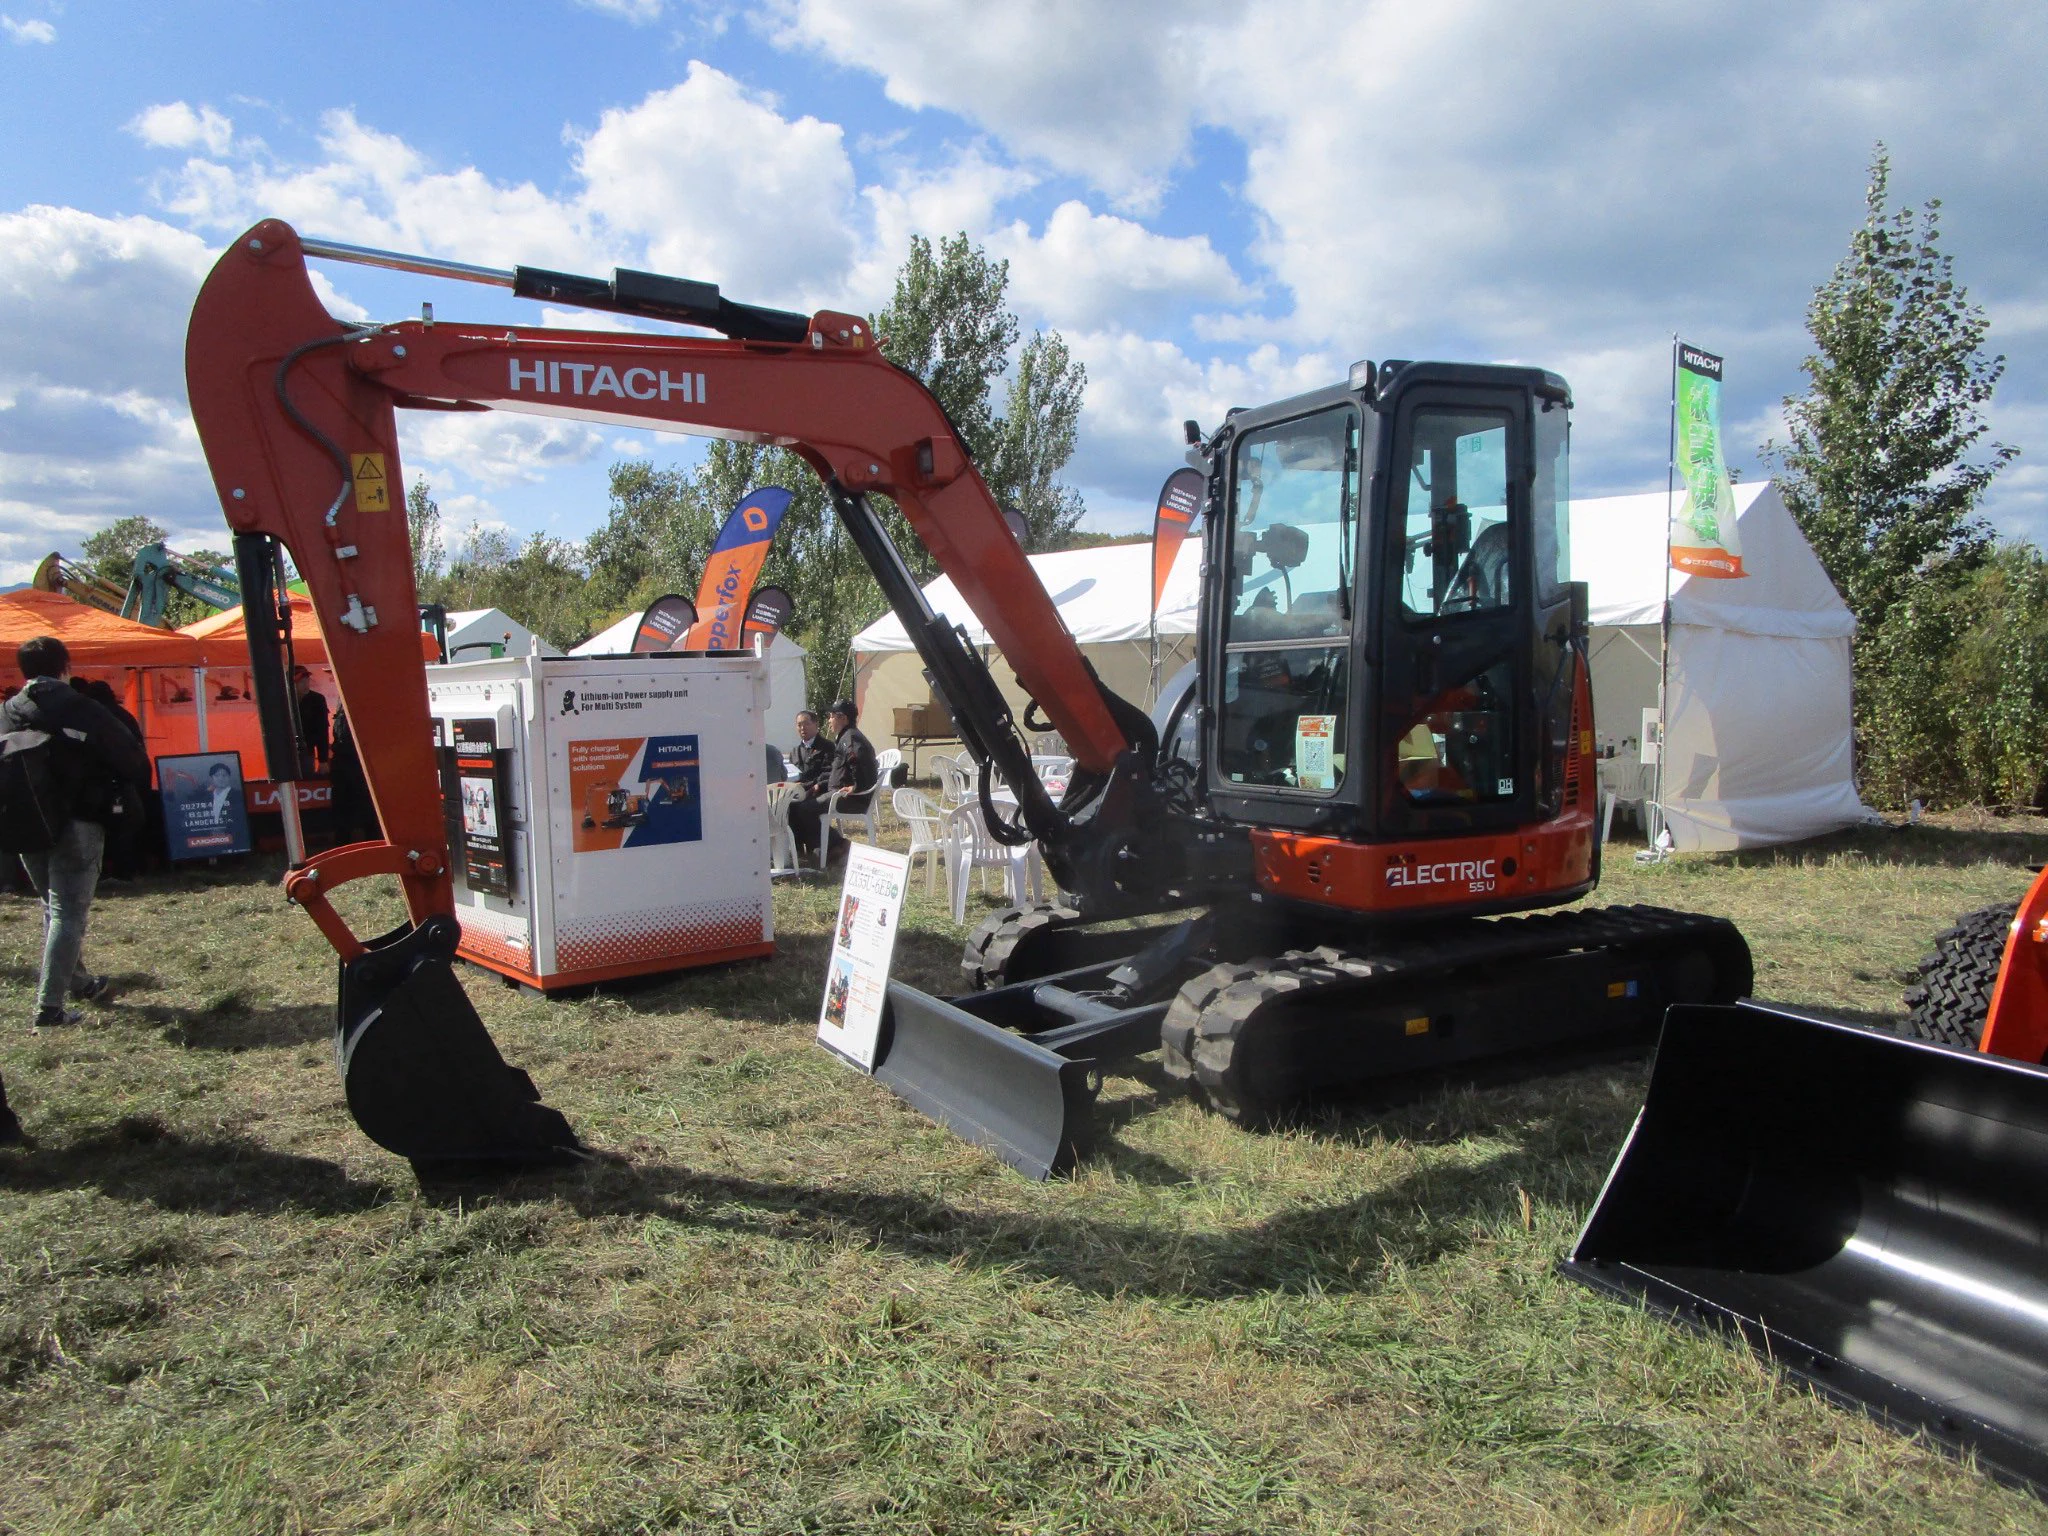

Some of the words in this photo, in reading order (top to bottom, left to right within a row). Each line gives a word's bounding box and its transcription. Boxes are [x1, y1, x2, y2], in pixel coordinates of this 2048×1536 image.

[1683, 350, 1720, 373] HITACHI
[509, 358, 706, 404] HITACHI
[580, 692, 624, 702] Lithium-ion
[625, 691, 648, 700] Power
[648, 690, 673, 699] supply
[673, 689, 689, 698] unit
[581, 702, 593, 711] For
[594, 701, 614, 711] Multi
[615, 701, 642, 711] System
[571, 746, 589, 754] Fully
[590, 744, 620, 753] charged
[658, 745, 692, 753] HITACHI
[589, 753, 629, 761] sustainable
[572, 763, 606, 772] solutions
[1385, 859, 1496, 887] ELECTRIC
